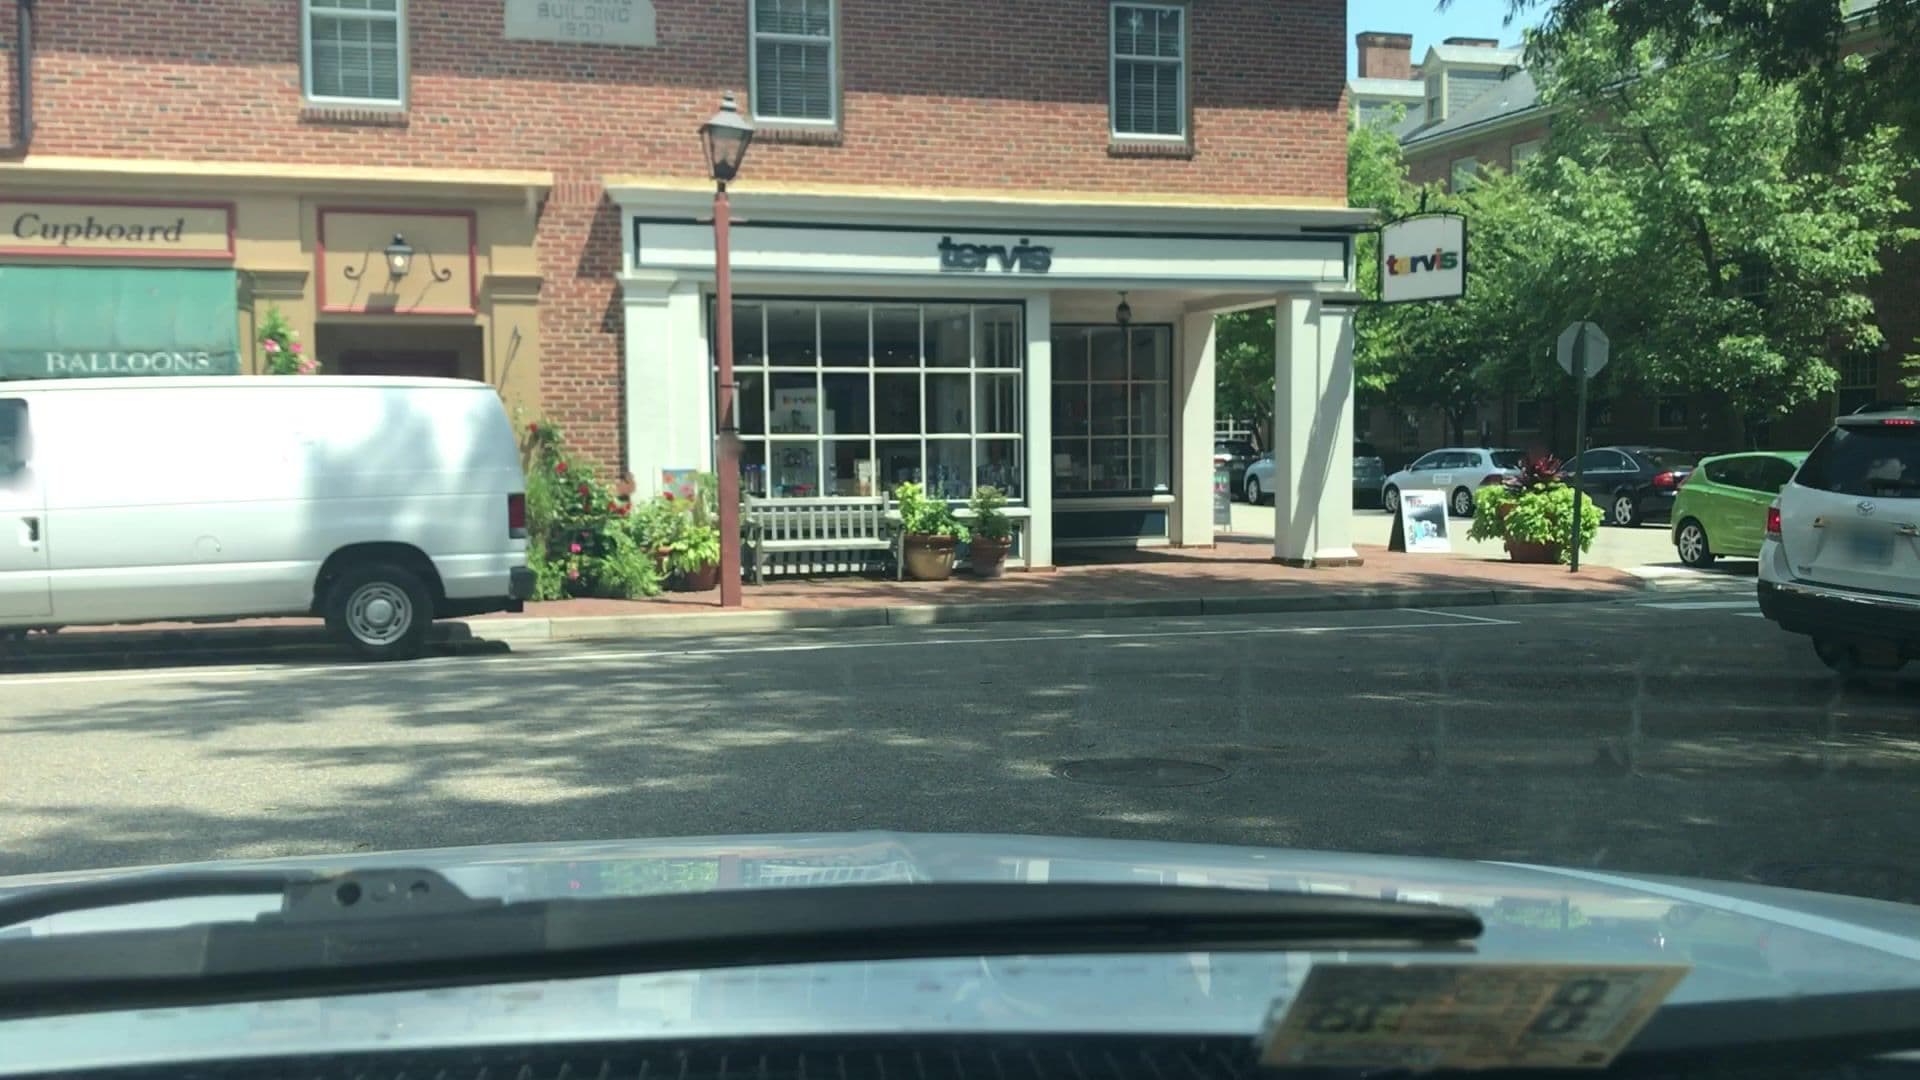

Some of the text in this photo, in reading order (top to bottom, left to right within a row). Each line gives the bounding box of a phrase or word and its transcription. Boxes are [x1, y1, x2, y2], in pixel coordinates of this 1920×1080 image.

[537, 2, 631, 22] BUILDING
[13, 213, 185, 246] Cupboard
[938, 235, 1053, 273] tervis
[1386, 247, 1458, 276] tervis
[46, 351, 210, 373] BALLOONS
